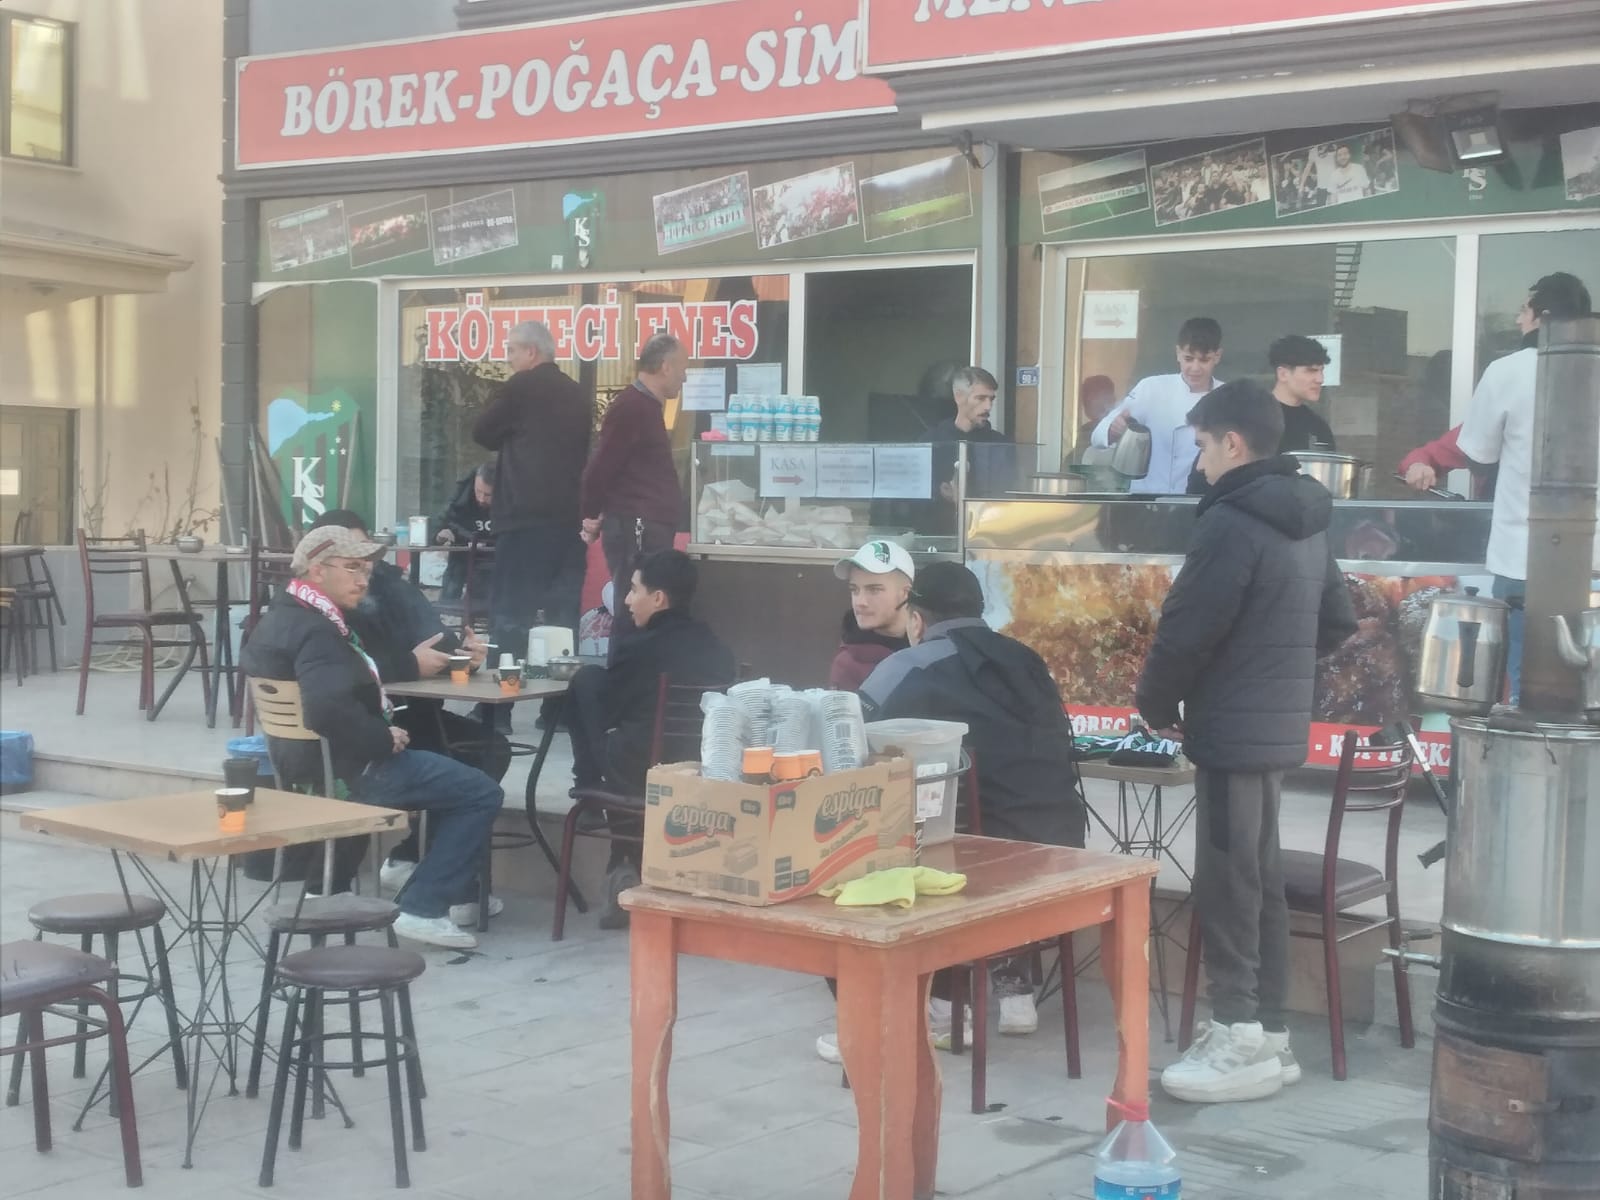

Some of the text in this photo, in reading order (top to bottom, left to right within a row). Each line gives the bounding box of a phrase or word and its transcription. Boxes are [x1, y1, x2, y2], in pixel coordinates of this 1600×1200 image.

[771, 457, 806, 471] KASA
[672, 802, 729, 838] espiga
[822, 783, 879, 822] espiga
